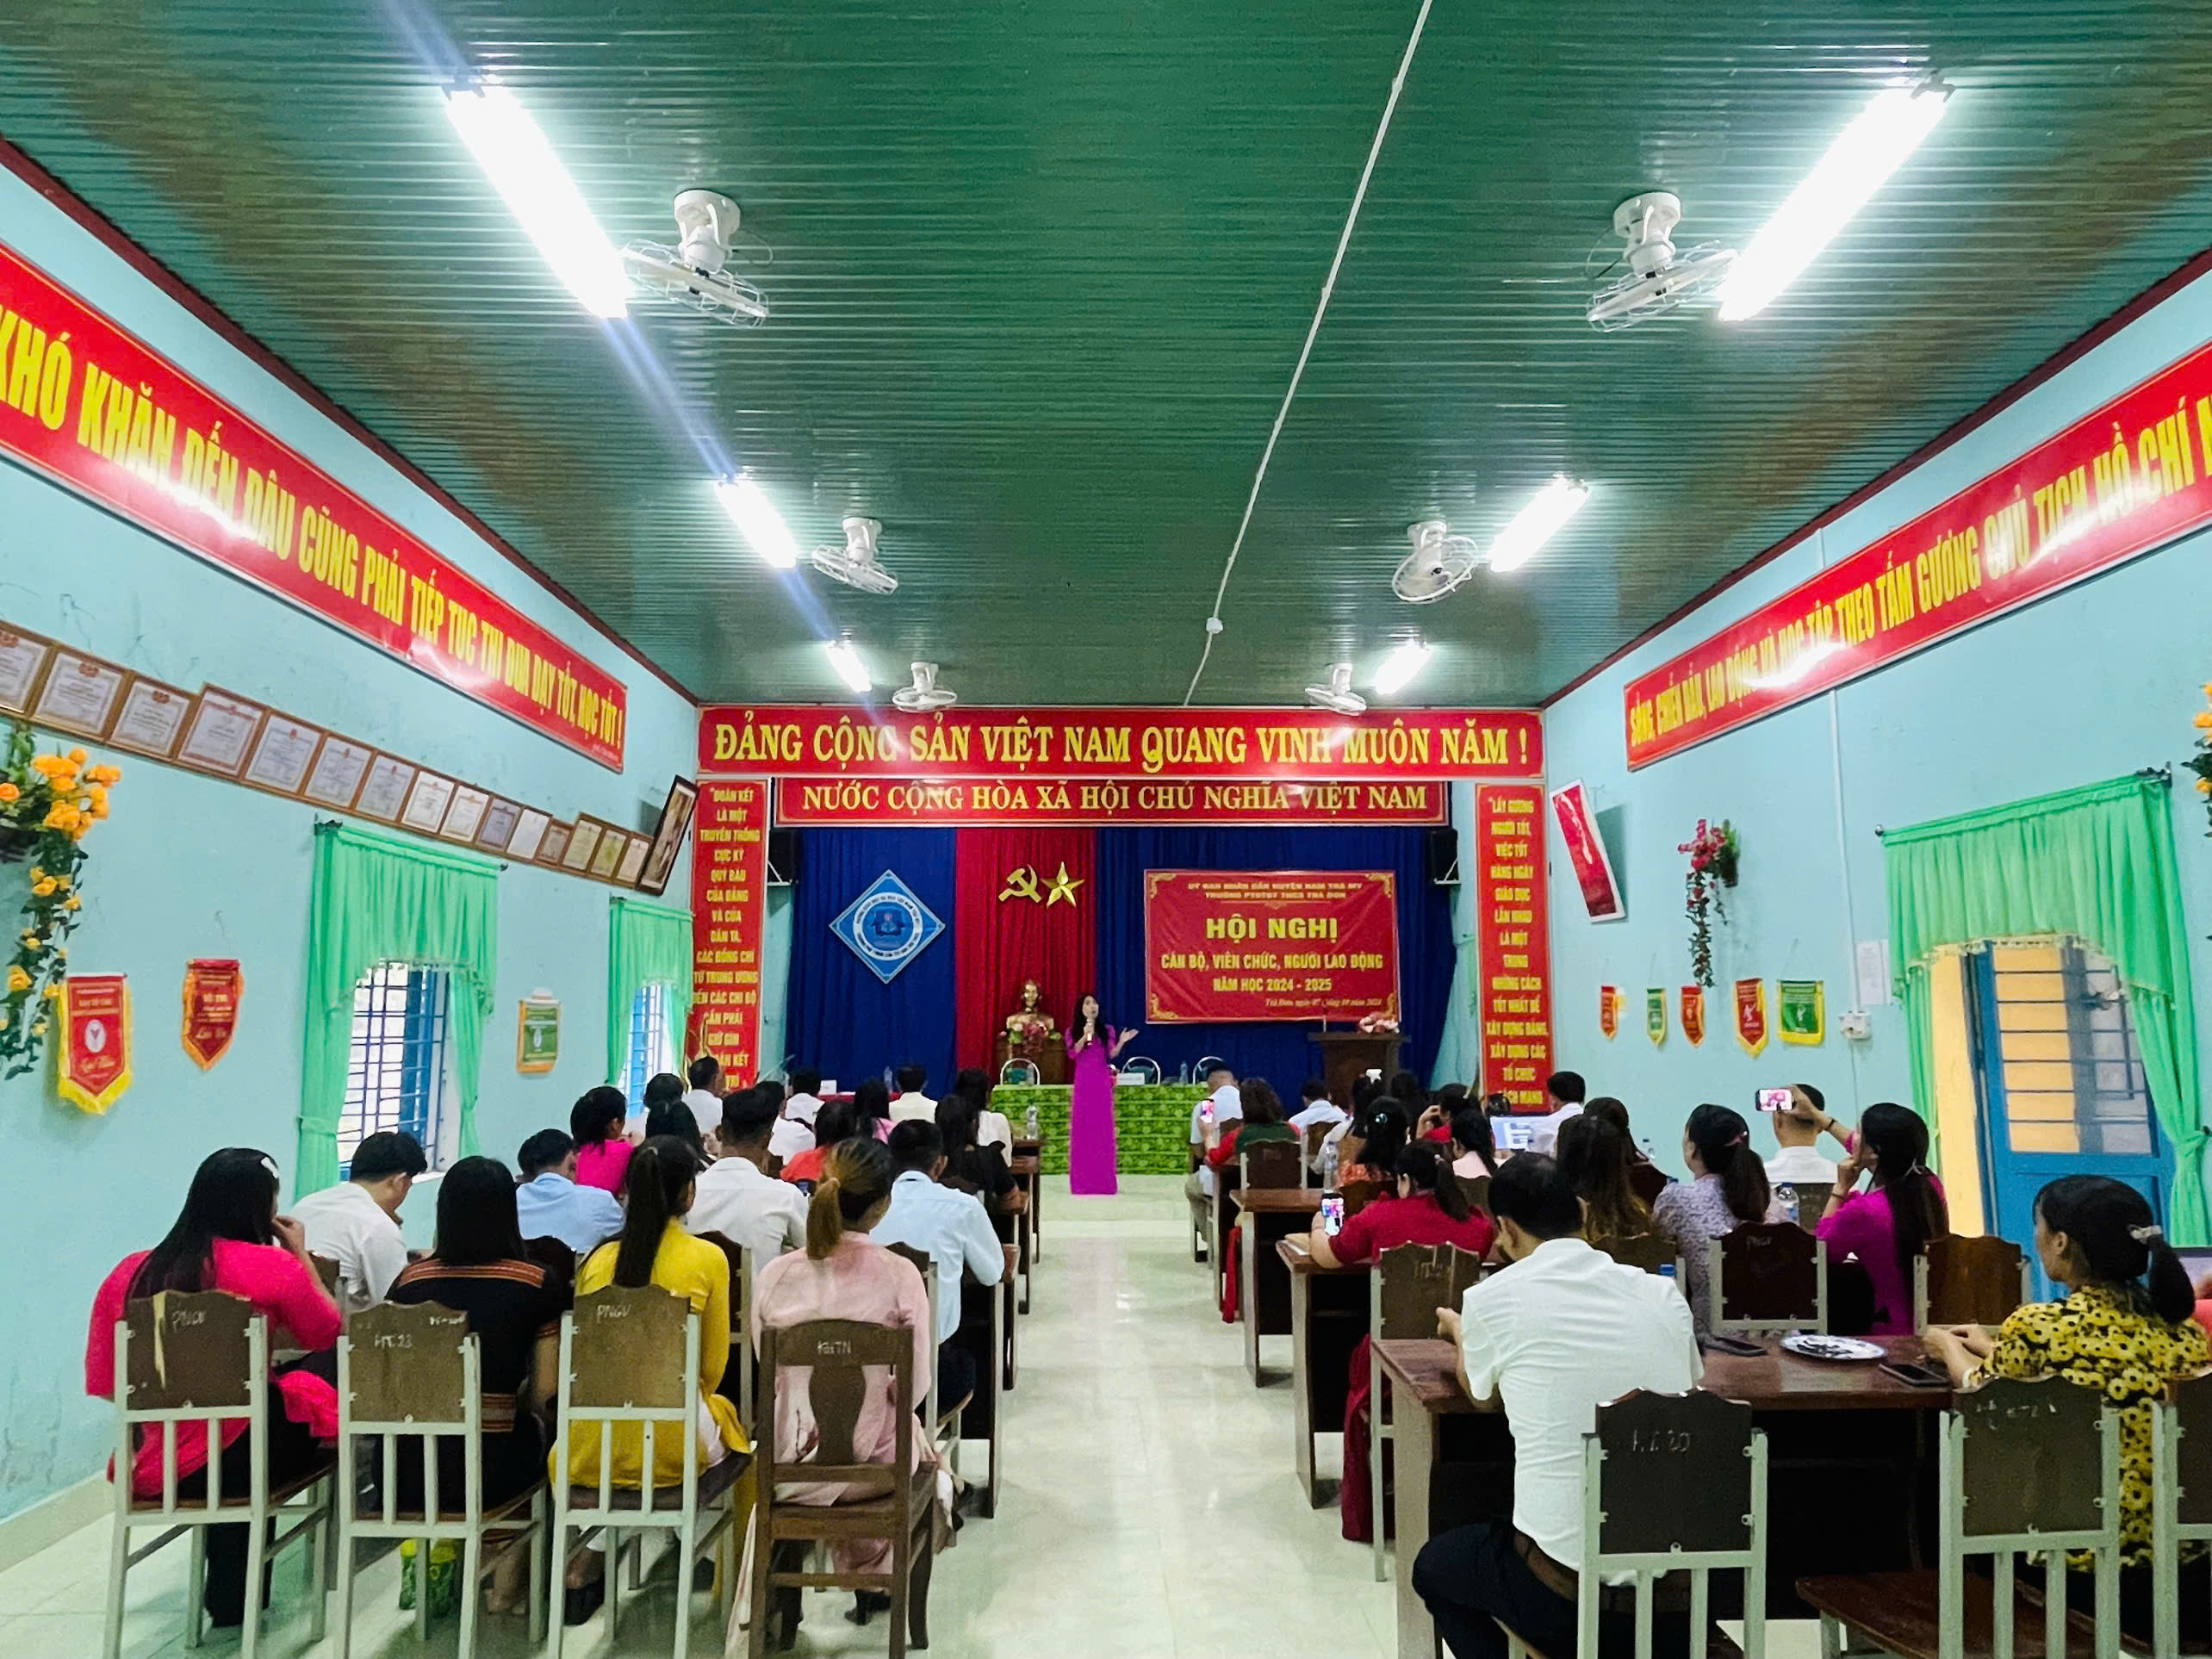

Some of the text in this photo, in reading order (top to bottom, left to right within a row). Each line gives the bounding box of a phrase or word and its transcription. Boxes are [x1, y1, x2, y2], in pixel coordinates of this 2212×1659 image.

[78, 361, 177, 488] KHĂN
[181, 420, 239, 522] ĐẾN
[244, 467, 296, 560] ĐÂU
[299, 505, 358, 599] CŨNG
[361, 544, 407, 626] PHẢI
[411, 569, 444, 645] TIẾP
[448, 599, 477, 668] TỤC
[481, 619, 504, 680] THI
[531, 655, 557, 716] DẠY
[1706, 659, 1725, 711] LAO
[1836, 582, 1875, 646] THEO
[1876, 550, 1915, 631] TẤM
[1917, 525, 1981, 613] GƯƠNG
[1984, 484, 2029, 581] CHỦ
[2093, 421, 2133, 524] HỒ
[2138, 396, 2195, 504] CHÍ
[715, 711, 1527, 773] ĐẢNG CỘNG SẢN VIỆT NAM QUANG VINH MUÔN NĂM !
[804, 779, 1426, 814] NƯỚC CỘNG HÒA XÃ HỘI CHỦ NGHĨA VIỆT NAM
[1206, 913, 1338, 943] HỘI NGHỊ
[1161, 950, 1383, 972] CÁN BỘ, VIÊN CHỨC, NGƯỜI LAO ĐỘNG
[1213, 976, 1238, 991] NĂM
[1240, 978, 1264, 994] HỌC
[1266, 978, 1294, 991] 2024
[1305, 978, 1332, 991] 2025
